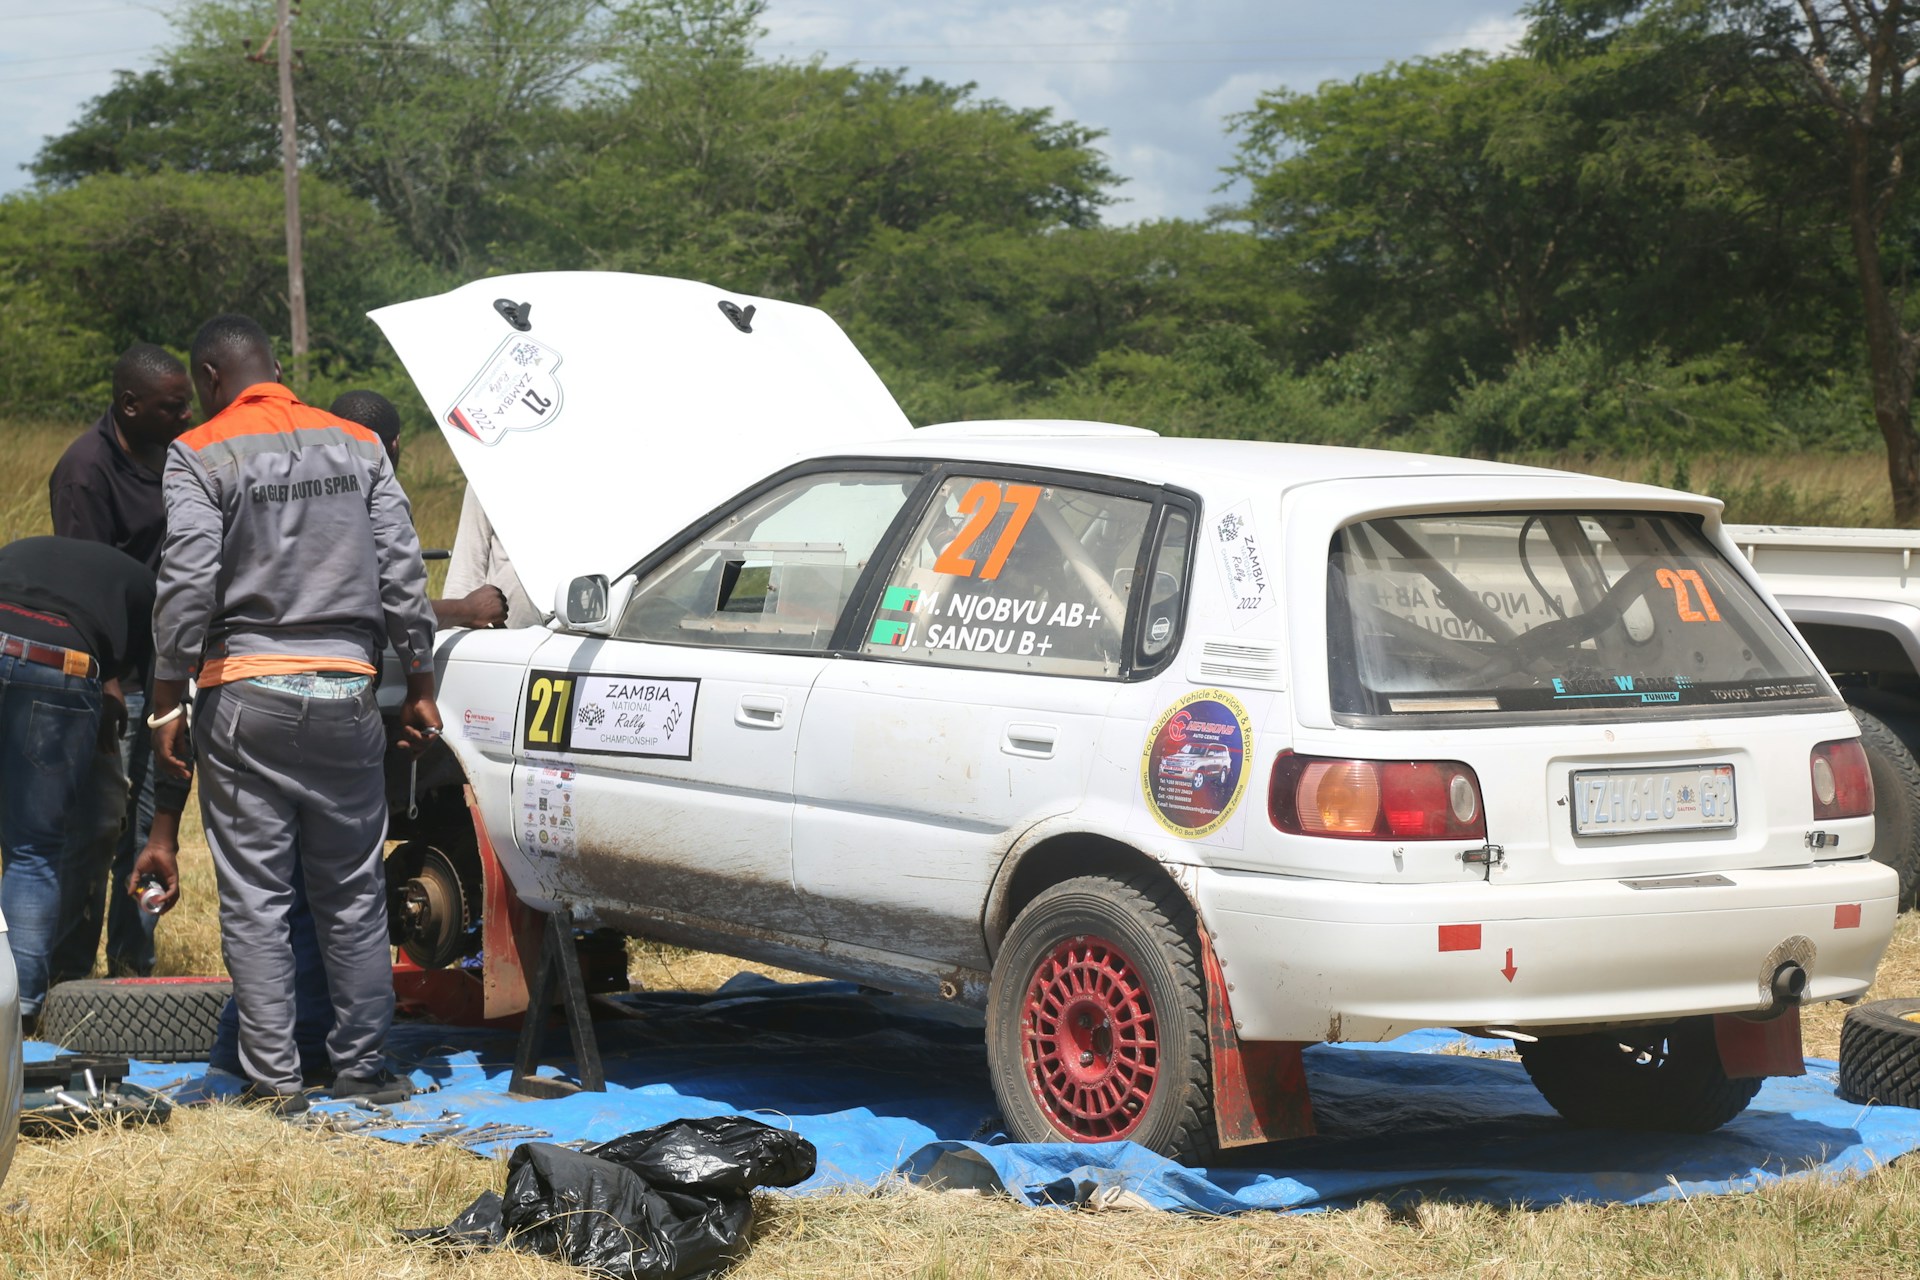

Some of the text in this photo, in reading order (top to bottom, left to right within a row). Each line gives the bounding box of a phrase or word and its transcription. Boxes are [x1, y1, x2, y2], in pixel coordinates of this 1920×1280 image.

[493, 372, 533, 415] ZAMBIA
[520, 388, 552, 416] 27
[466, 407, 496, 431] 2022
[251, 474, 361, 504] EAGLET AUTO SPAR
[933, 481, 1042, 580] 27
[1232, 555, 1246, 583] Rally
[1244, 534, 1266, 594] ZAMBIA
[914, 591, 1102, 628] M. NJOBVU AB+
[1236, 597, 1262, 610] 2022
[1655, 568, 1722, 622] 27
[902, 623, 1053, 656] J. SANDU B+
[605, 684, 671, 702] ZAMBIA
[1644, 693, 1677, 701] TUNING
[1710, 683, 1818, 700] TOYOTA CONQUEST
[529, 677, 572, 743] 27
[611, 701, 652, 713] NATIONAL
[662, 702, 683, 740] 2022
[614, 713, 646, 735] Rally
[1143, 690, 1252, 763] For Quality Vehicle Servicing & Repair
[600, 734, 658, 746] CHAMPIONSHIP
[1575, 774, 1732, 824] VZH616 GP
